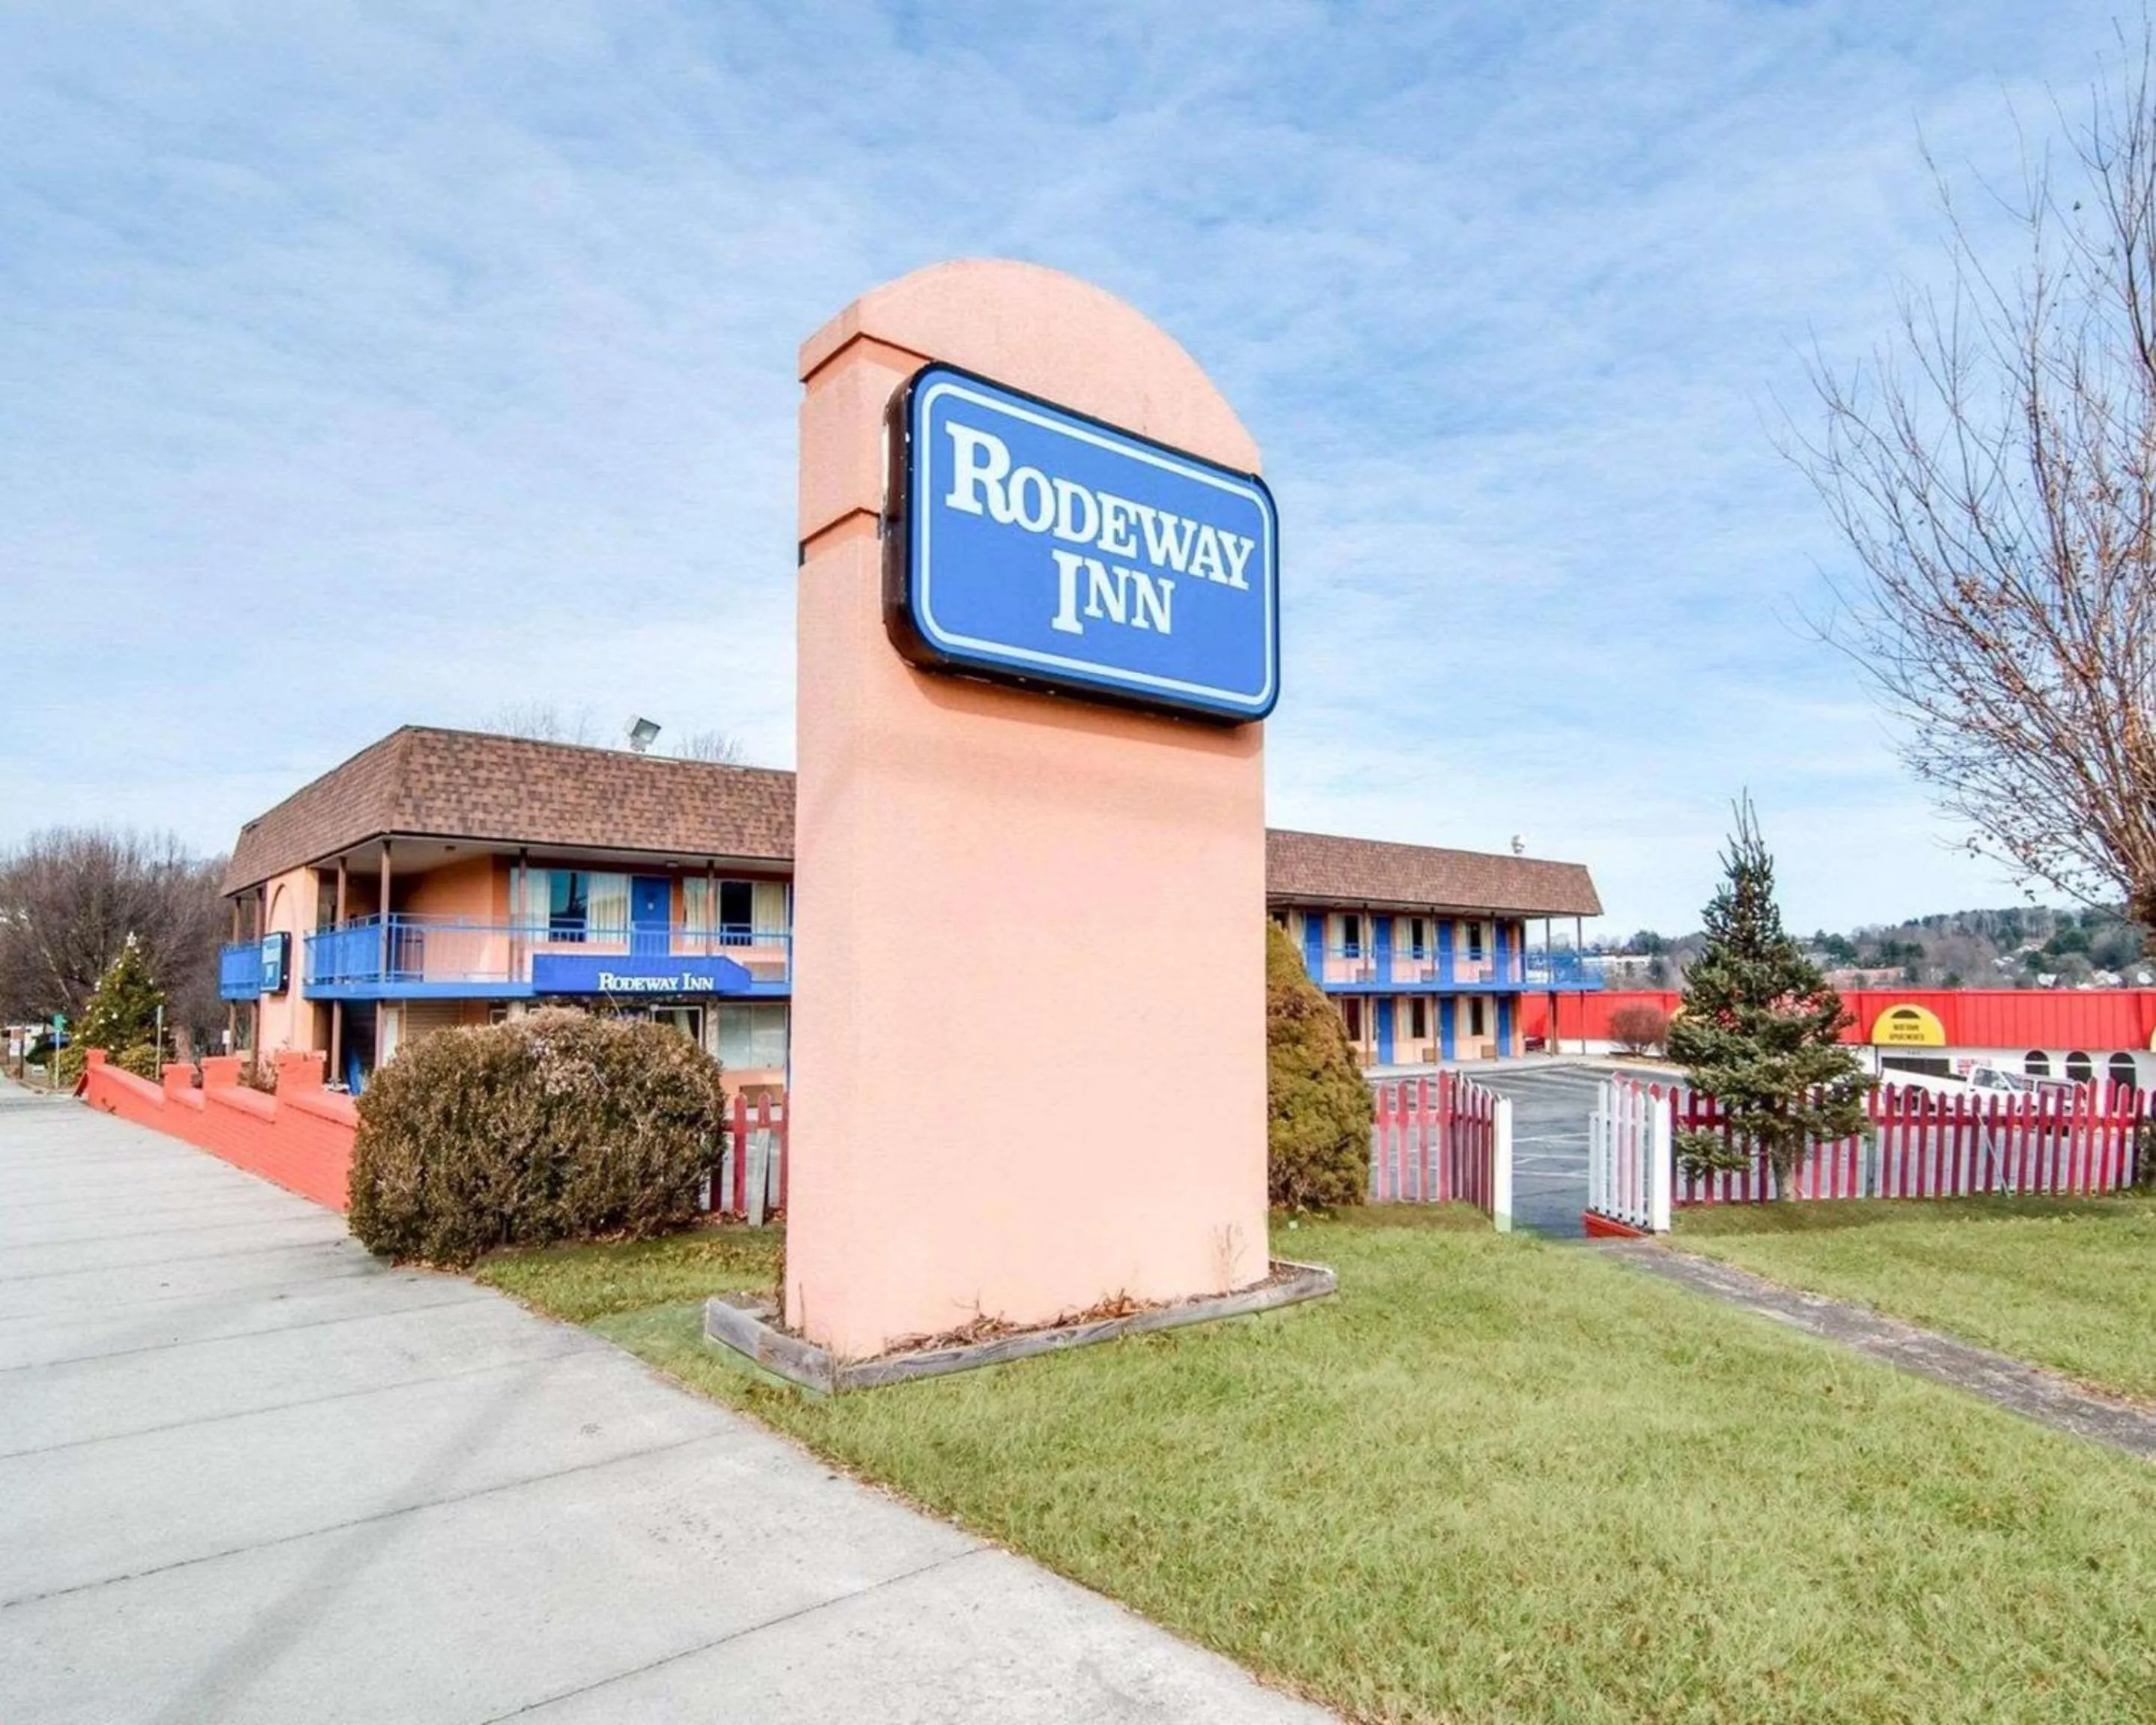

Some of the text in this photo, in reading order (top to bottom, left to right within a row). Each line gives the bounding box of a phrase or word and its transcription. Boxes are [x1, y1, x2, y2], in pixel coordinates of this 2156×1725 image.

[945, 421, 1255, 590] RODEWAY
[1052, 548, 1175, 634] INN
[600, 973, 714, 991] RODEWAY INN
